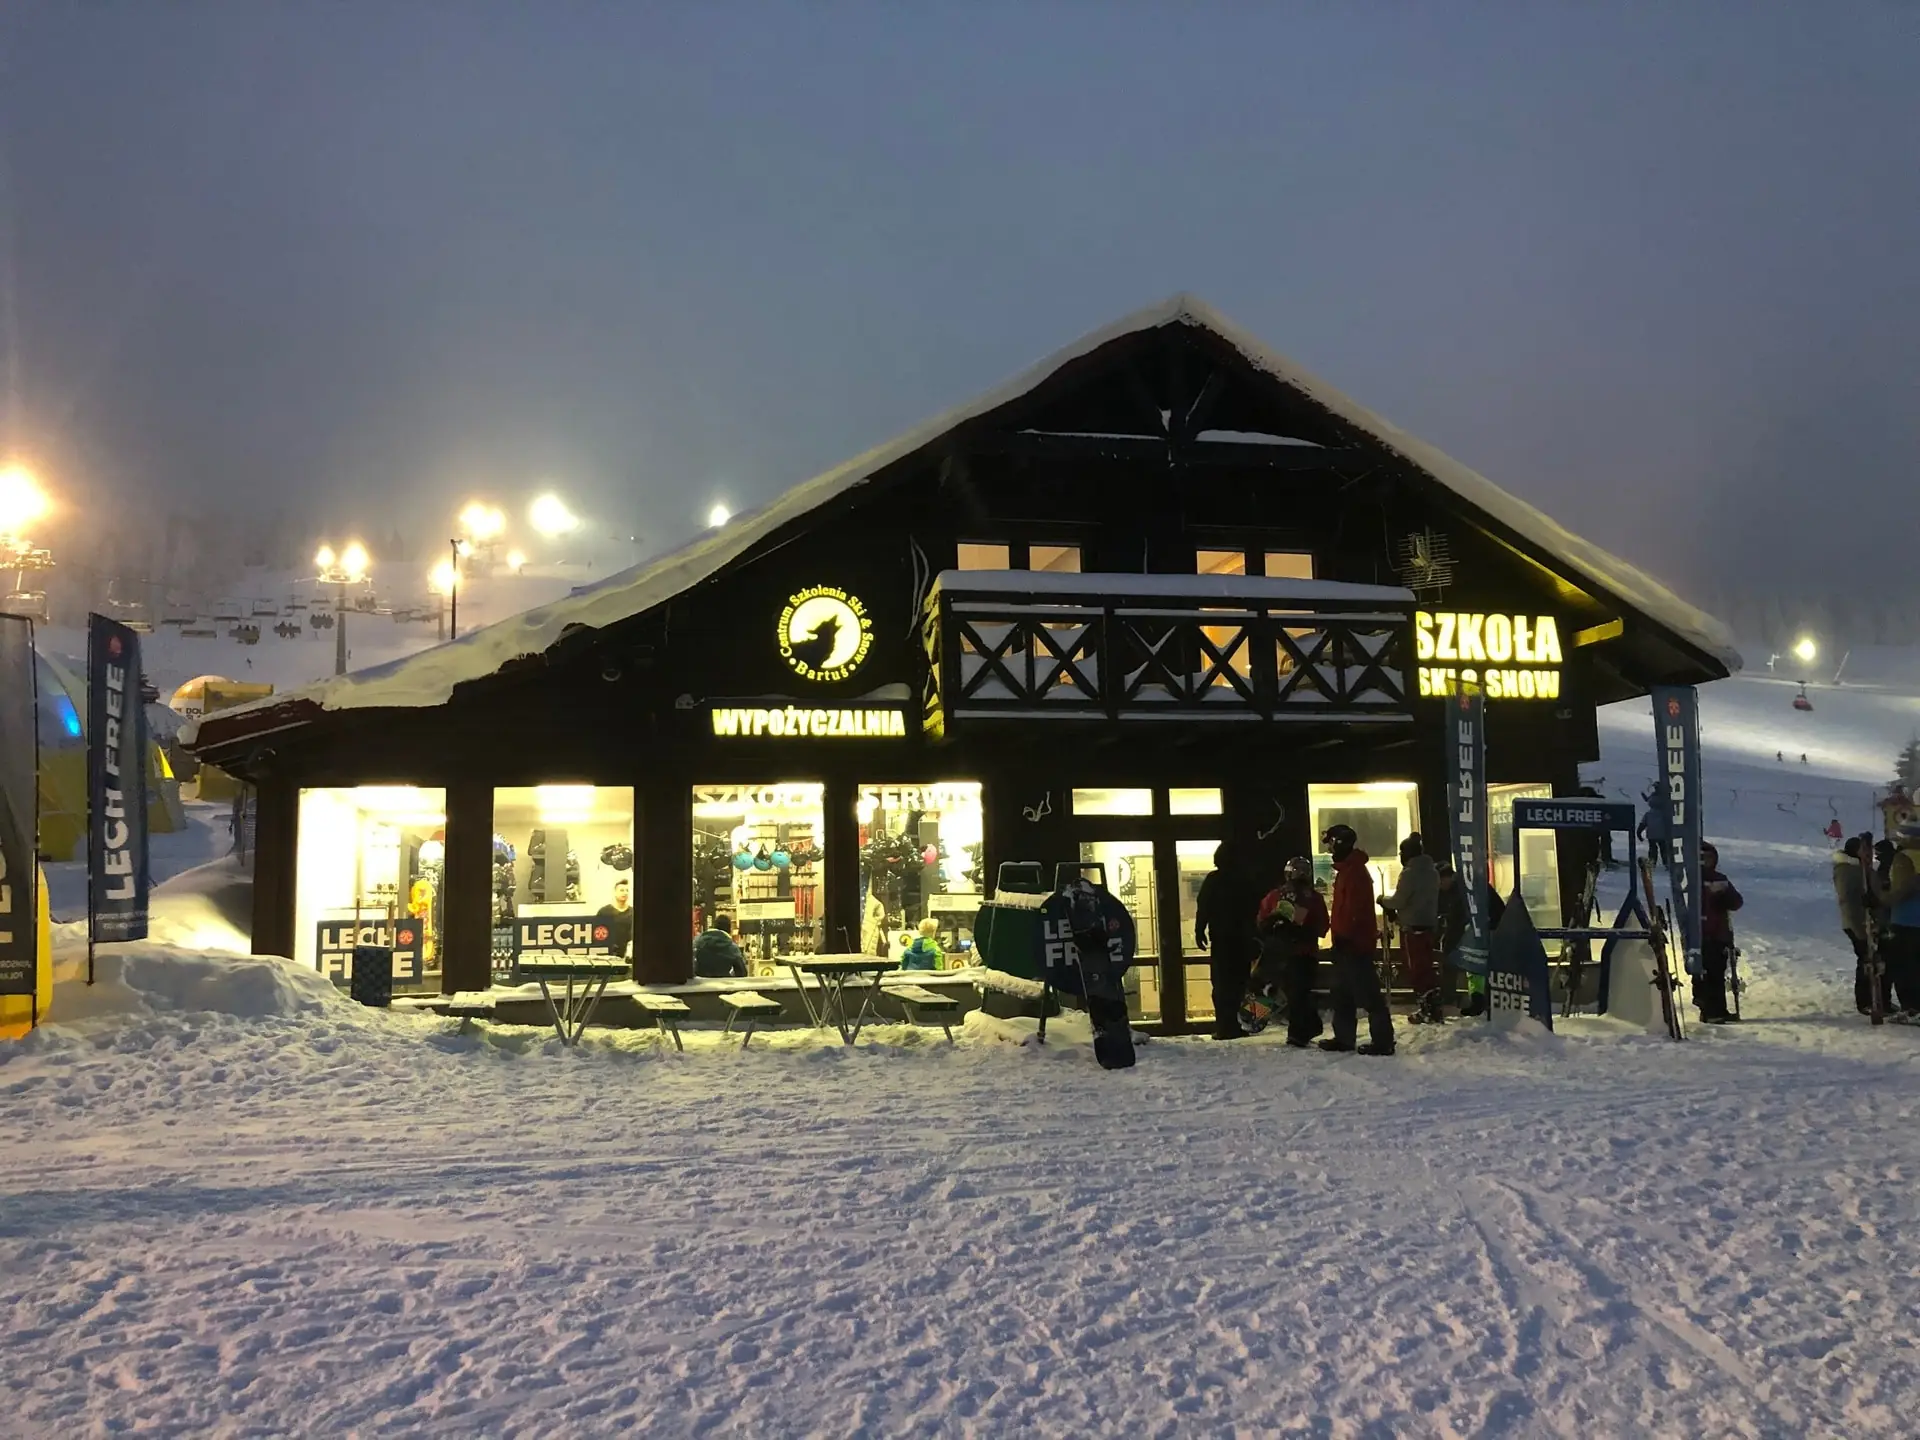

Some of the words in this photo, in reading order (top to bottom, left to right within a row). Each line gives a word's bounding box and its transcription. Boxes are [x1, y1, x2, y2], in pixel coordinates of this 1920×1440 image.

[789, 584, 847, 607] Szkolenia
[847, 596, 868, 617] Ski
[777, 606, 794, 657] Centrum
[860, 618, 873, 629] &
[1415, 611, 1563, 662] SZKOŁA
[854, 632, 874, 664] Snow
[1418, 667, 1457, 696] SKI
[1485, 669, 1560, 698] SNOW
[105, 663, 125, 776] FREE
[711, 705, 906, 736] WYPOŻYCZALNIA
[1527, 808, 1564, 821] LECH
[1566, 810, 1602, 822] FREE
[104, 787, 136, 900] LECH
[322, 927, 397, 950] LECH
[521, 923, 593, 946] LECH
[322, 951, 414, 979] FE
[1045, 938, 1124, 967] FRE
[1489, 971, 1522, 991] LECH
[1490, 990, 1530, 1016] FREE
